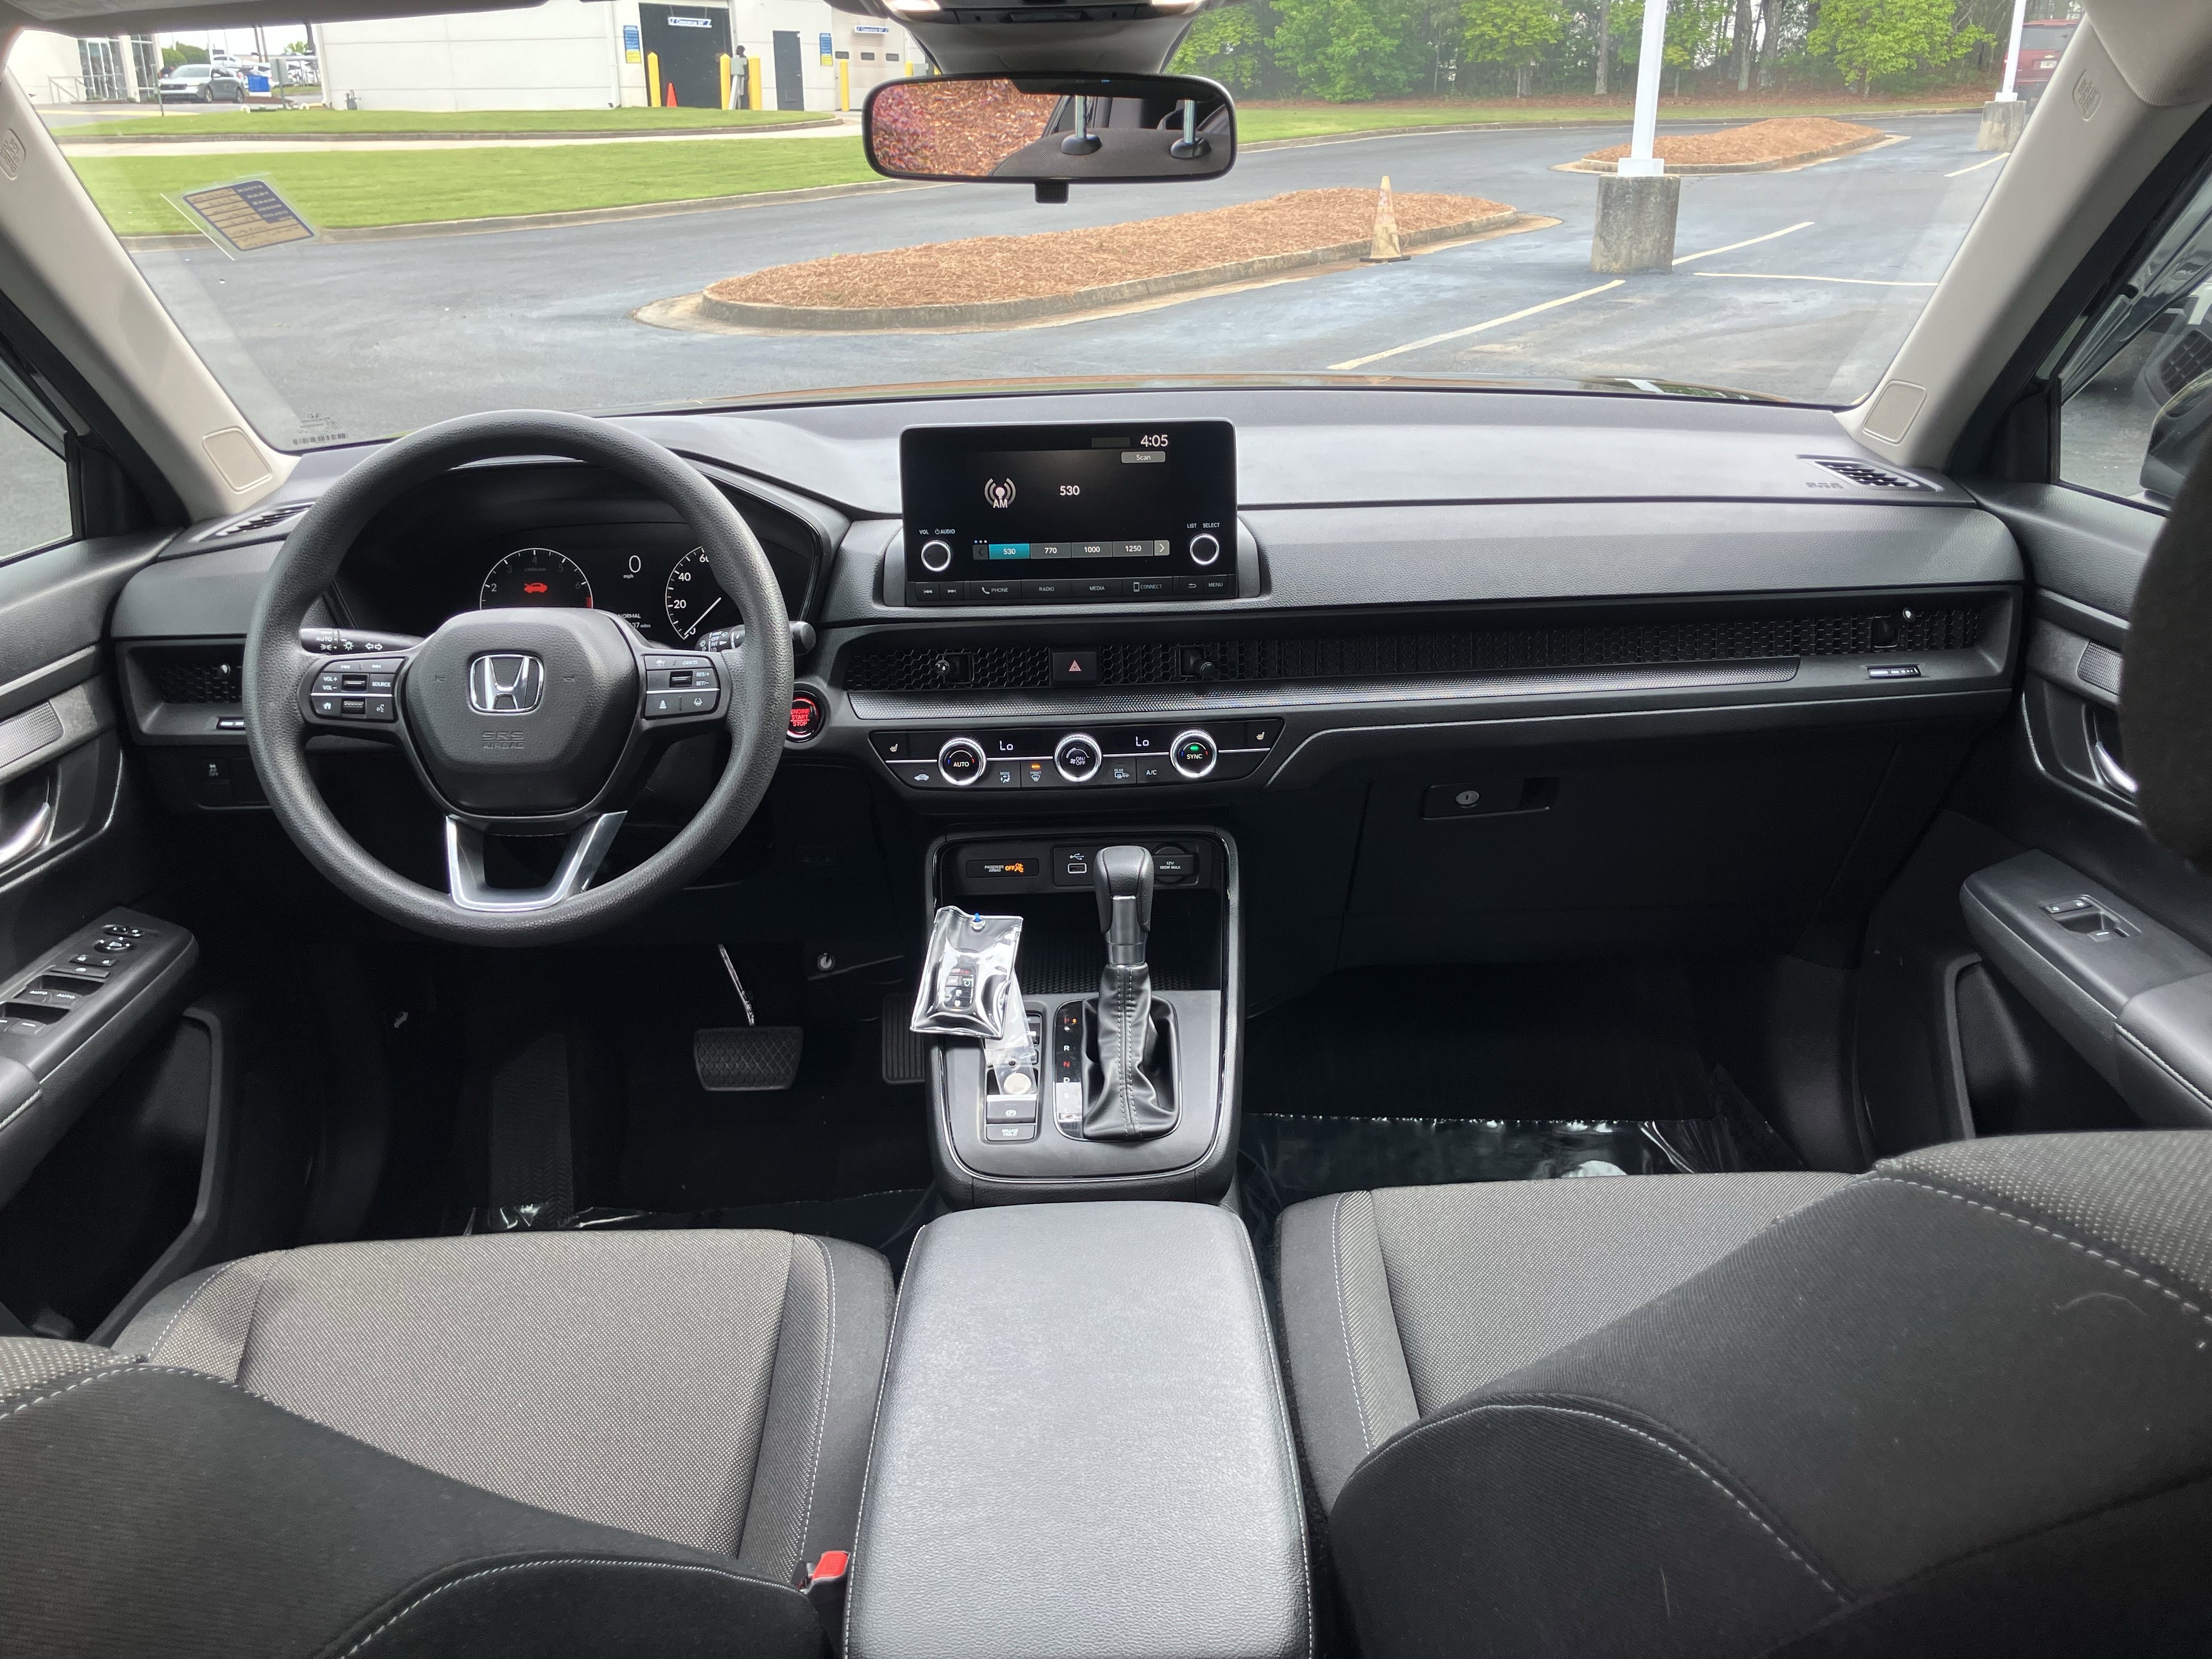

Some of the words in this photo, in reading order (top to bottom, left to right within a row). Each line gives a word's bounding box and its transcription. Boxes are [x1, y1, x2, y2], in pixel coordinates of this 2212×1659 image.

[1140, 434, 1168, 447] 4:05
[1059, 485, 1080, 496] 530
[992, 499, 1008, 509] AM
[532, 556, 537, 564] 4
[629, 555, 641, 573] 0
[506, 565, 512, 573] 3
[558, 564, 564, 572] 5
[678, 572, 691, 582] 40
[491, 583, 497, 592] 2
[575, 581, 581, 590] 6
[673, 599, 687, 609] 20
[482, 731, 524, 740] SRS
[999, 740, 1014, 751] Lo
[1135, 736, 1149, 747] Lo
